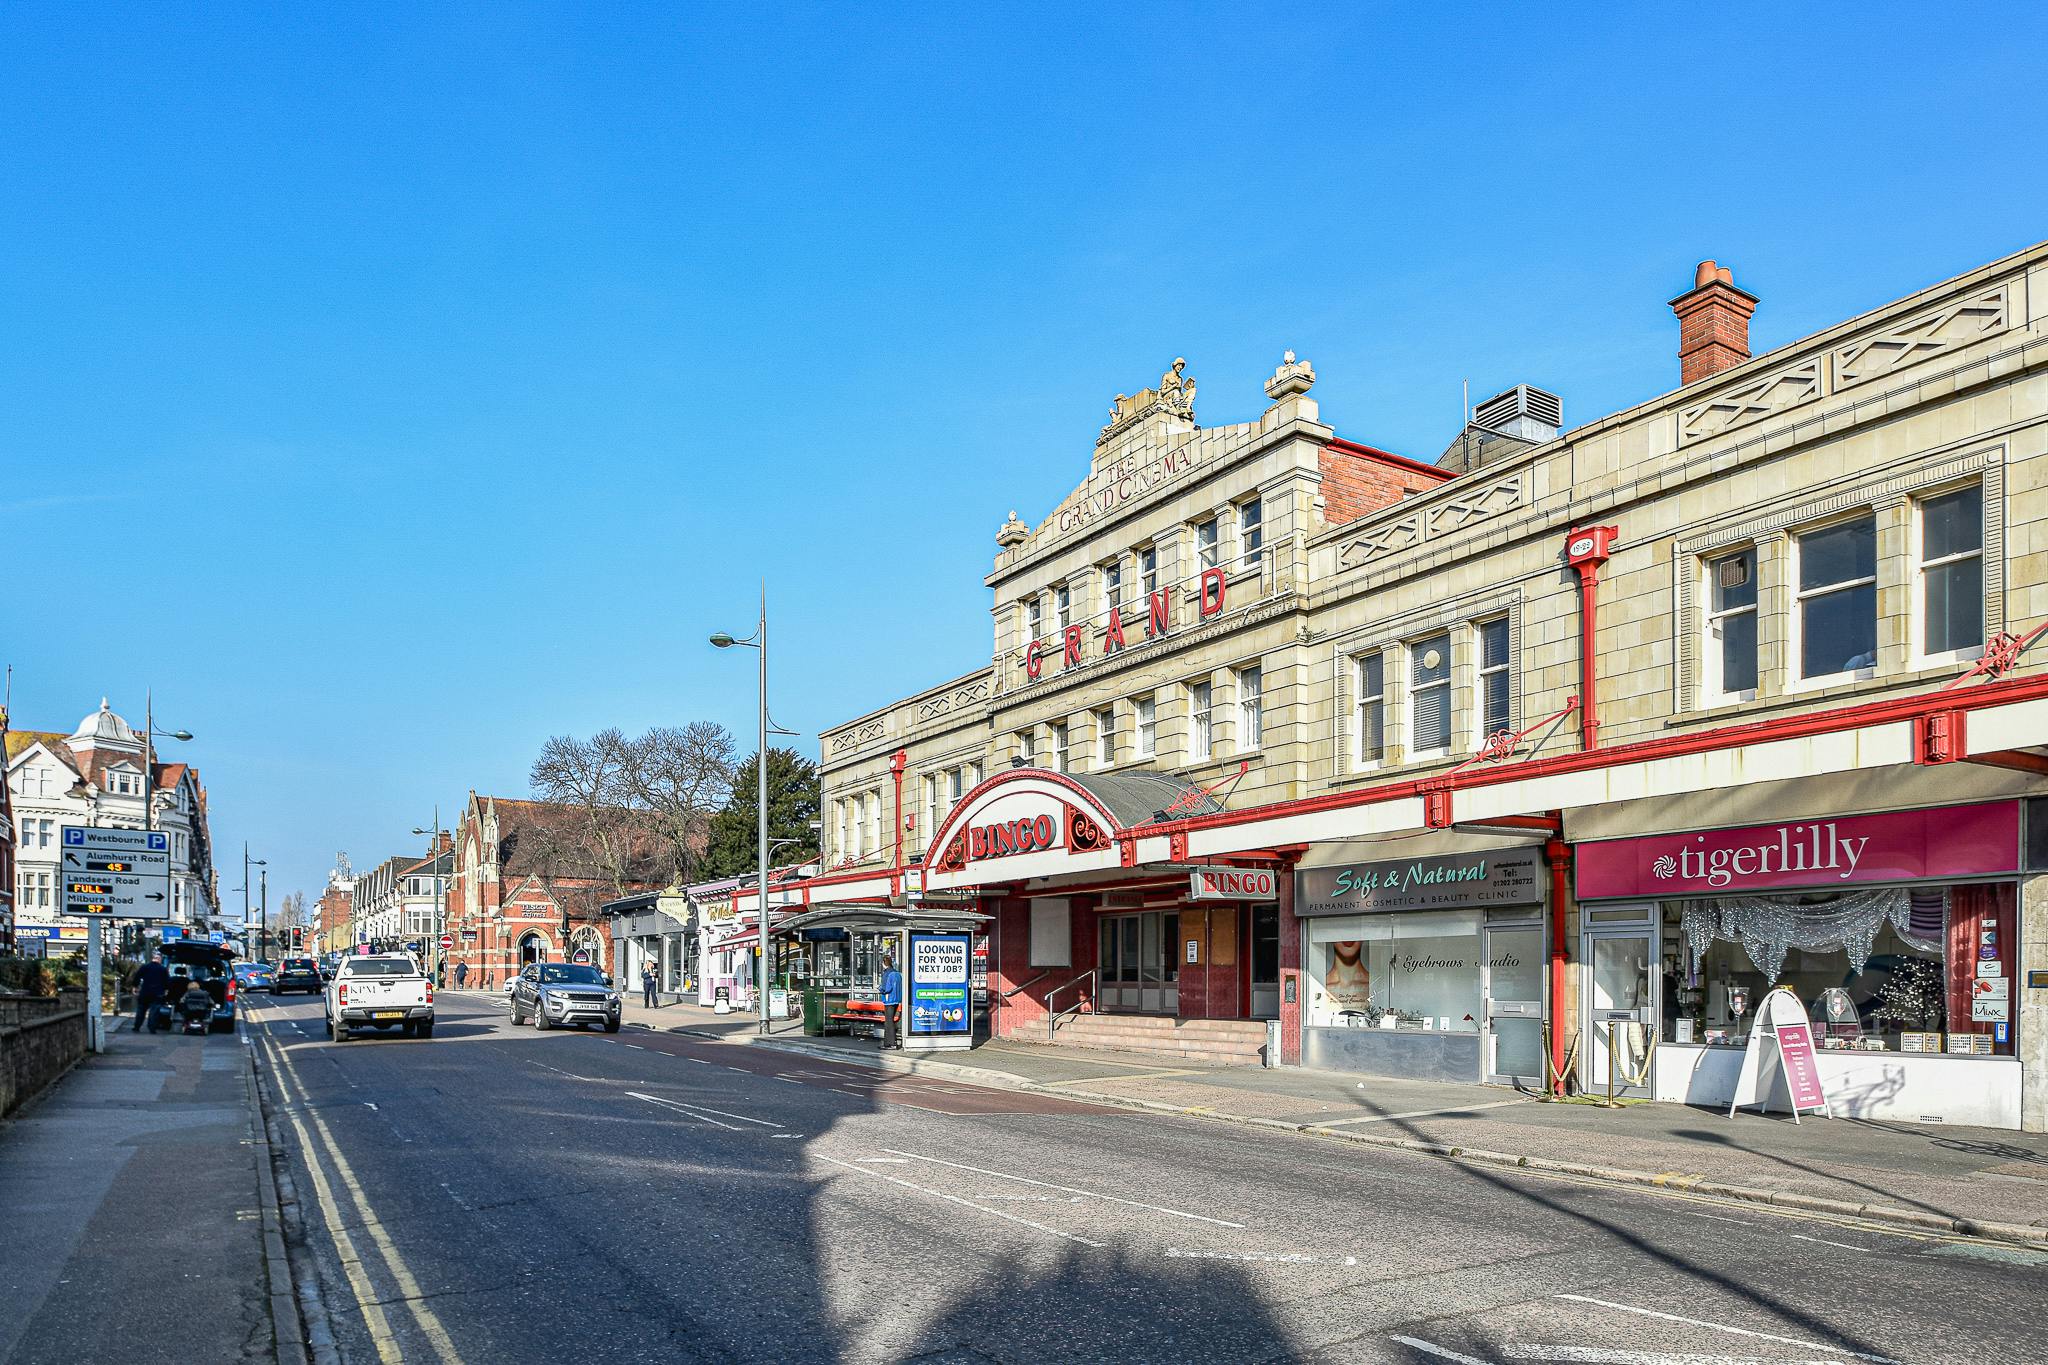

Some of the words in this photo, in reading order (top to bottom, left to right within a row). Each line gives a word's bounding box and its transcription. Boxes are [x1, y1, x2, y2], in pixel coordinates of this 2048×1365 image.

[1107, 456, 1136, 483] THE
[1060, 488, 1114, 532] GRAND
[1119, 448, 1190, 500] CINEMA
[1027, 568, 1226, 679] GRAND
[87, 834, 145, 844] Westbourne
[971, 814, 1056, 858] BINGO
[87, 852, 137, 862] Alumhurst
[141, 855, 165, 863] Road
[1681, 823, 1869, 886] tigerlilly
[107, 863, 123, 871] 45
[1503, 869, 1517, 877] Tel:
[68, 875, 112, 883] Landseer
[116, 877, 140, 885] Road
[1203, 872, 1271, 895] BINGO
[1331, 870, 1378, 899] Soft
[1383, 871, 1399, 888] &
[1402, 860, 1488, 893] Natural
[74, 884, 103, 893] FULL
[67, 895, 105, 903] Milburn
[109, 896, 133, 904] Road
[1309, 901, 1361, 911] PERMANENT
[1365, 897, 1415, 908] COSMETIC
[1431, 894, 1470, 903] BEAUTY
[1478, 890, 1518, 899] CLINIC
[88, 904, 104, 913] 57
[918, 945, 963, 954] LOOKING
[918, 956, 936, 964] FOR
[939, 956, 963, 964] YOUR
[1403, 955, 1465, 973] Eyebrows
